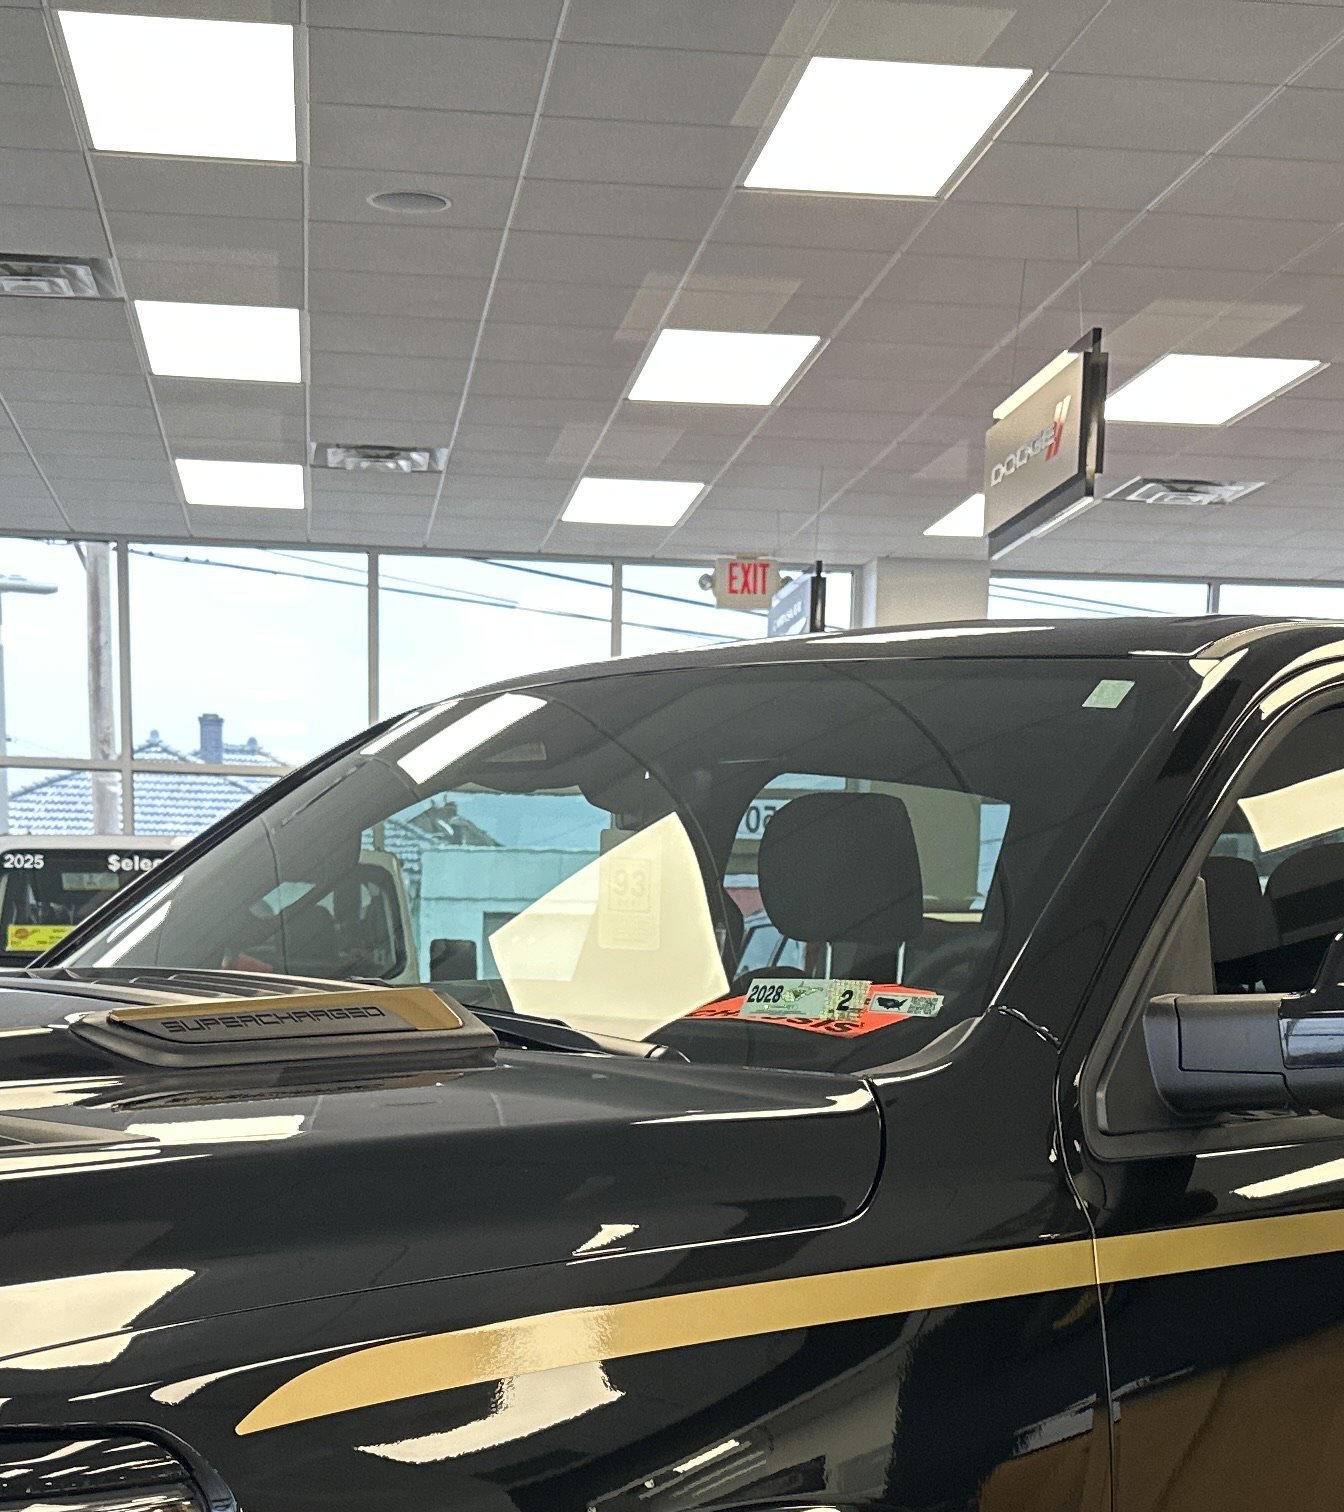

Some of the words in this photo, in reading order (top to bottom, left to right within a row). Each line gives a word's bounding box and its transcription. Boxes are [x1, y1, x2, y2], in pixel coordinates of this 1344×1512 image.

[728, 562, 770, 595] EXIT
[3, 854, 45, 869] 2025
[747, 985, 785, 1003] 2028
[836, 990, 854, 1011] 2
[162, 1006, 385, 1033] SUPERCHARGED
